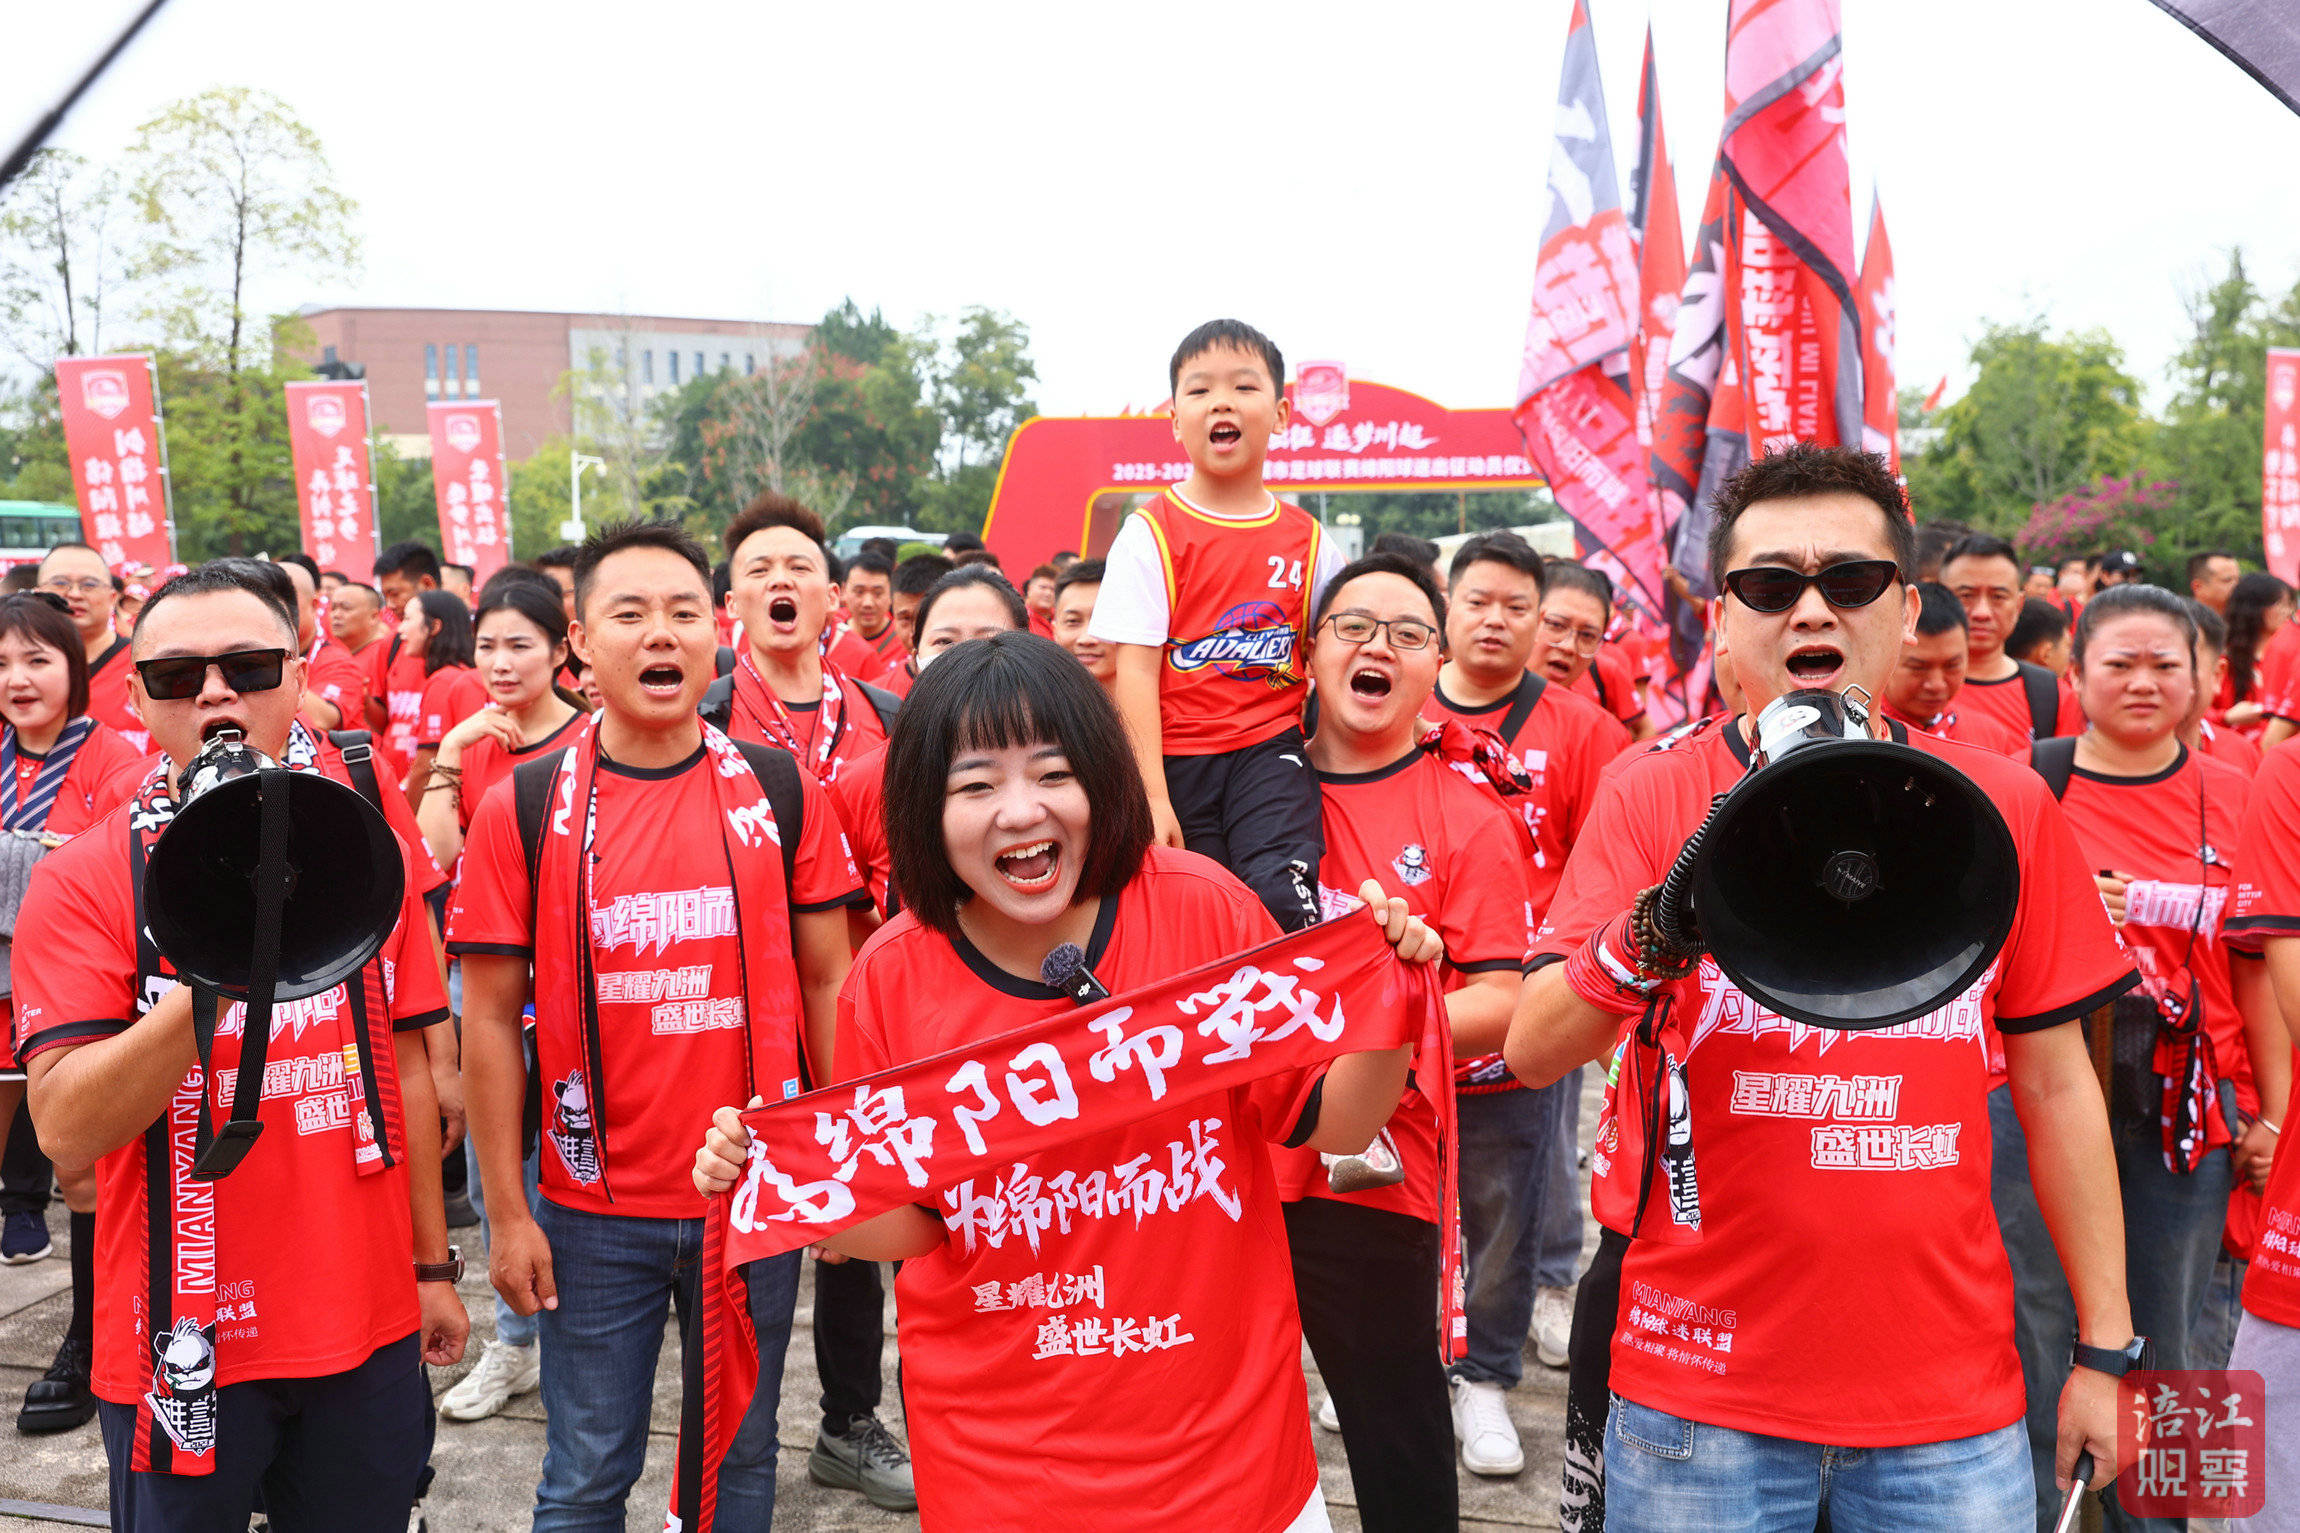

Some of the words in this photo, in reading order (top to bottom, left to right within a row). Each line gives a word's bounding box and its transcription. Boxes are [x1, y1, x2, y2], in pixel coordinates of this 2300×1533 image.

[1267, 555, 1303, 593] 24
[597, 964, 713, 1004] 星耀九洲
[1730, 1070, 1903, 1121] 星耀九洲
[1811, 1123, 1962, 1171] 盛世长虹
[971, 1264, 1105, 1312] 星耀九洲
[1632, 1280, 1737, 1329] MIANYANG
[1032, 1314, 1195, 1360] 盛世长虹
